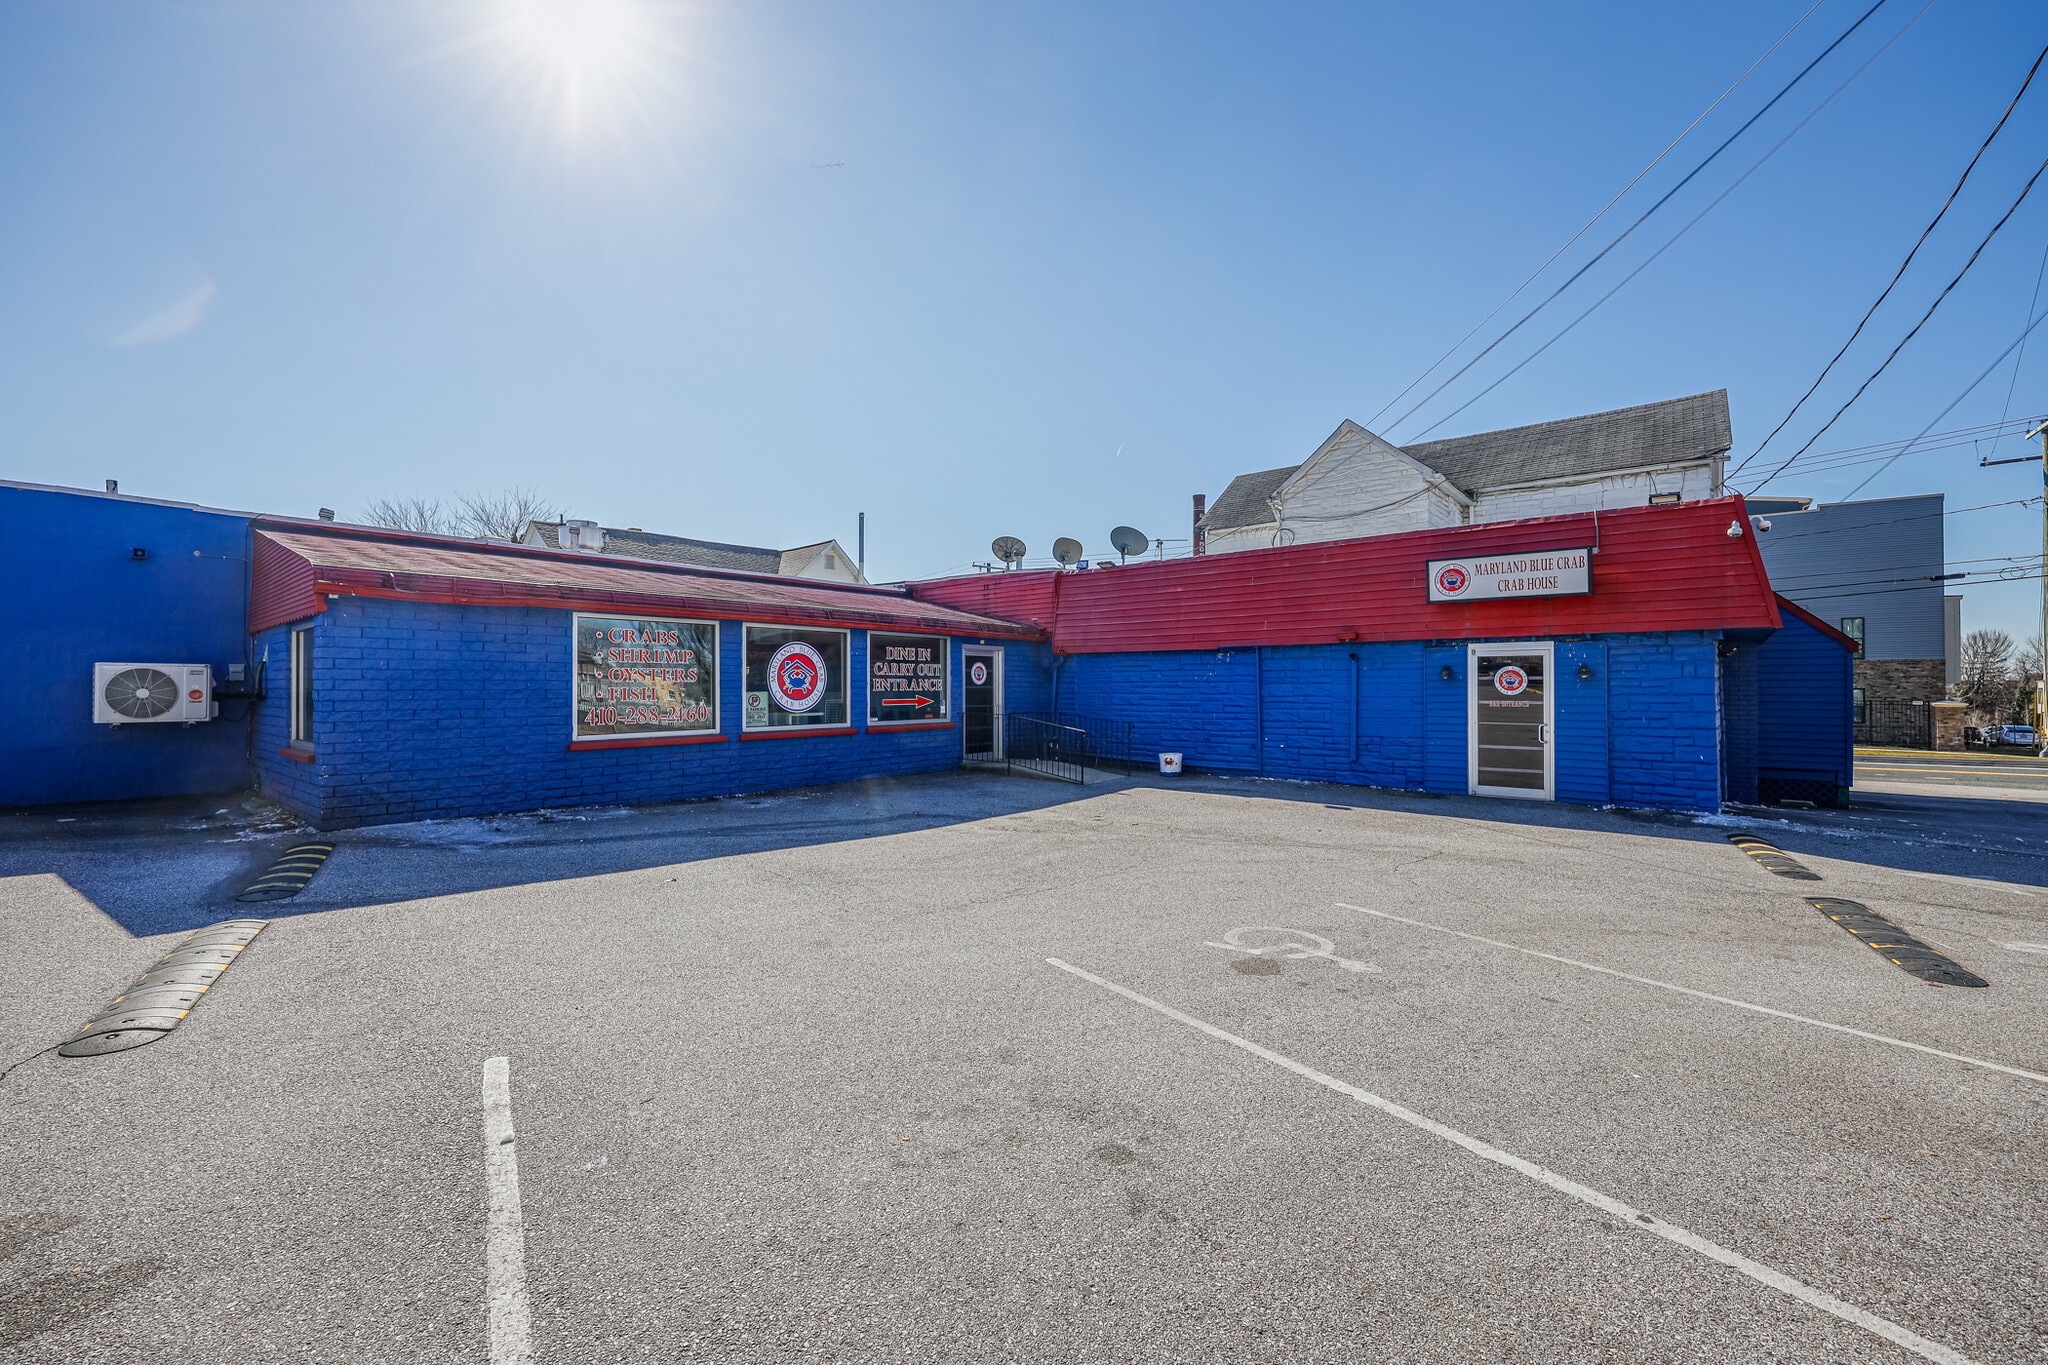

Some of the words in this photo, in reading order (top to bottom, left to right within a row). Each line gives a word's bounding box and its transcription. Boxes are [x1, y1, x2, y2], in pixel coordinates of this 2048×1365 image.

[1474, 562, 1527, 576] MARYLAND
[1529, 558, 1554, 571] BLUE
[1556, 555, 1585, 570] CRAB
[1497, 578, 1524, 592] CRAB
[1527, 576, 1559, 590] HOUSE
[607, 628, 679, 645] CRABS
[607, 647, 694, 664] SHRIMP
[885, 646, 916, 660] DINE
[918, 647, 932, 661] IN
[771, 646, 796, 683] MARYLAND
[799, 646, 816, 659] BLUE
[815, 661, 825, 683] CRAB
[873, 662, 915, 676] CARRY
[918, 664, 941, 676] OUT
[607, 668, 697, 683] OYSTERS
[872, 678, 942, 692] ENTRANCE
[607, 686, 658, 702] FISH
[774, 690, 795, 708] CRAB
[798, 688, 822, 708] HOUSE
[585, 705, 708, 726] 410-288-2460
